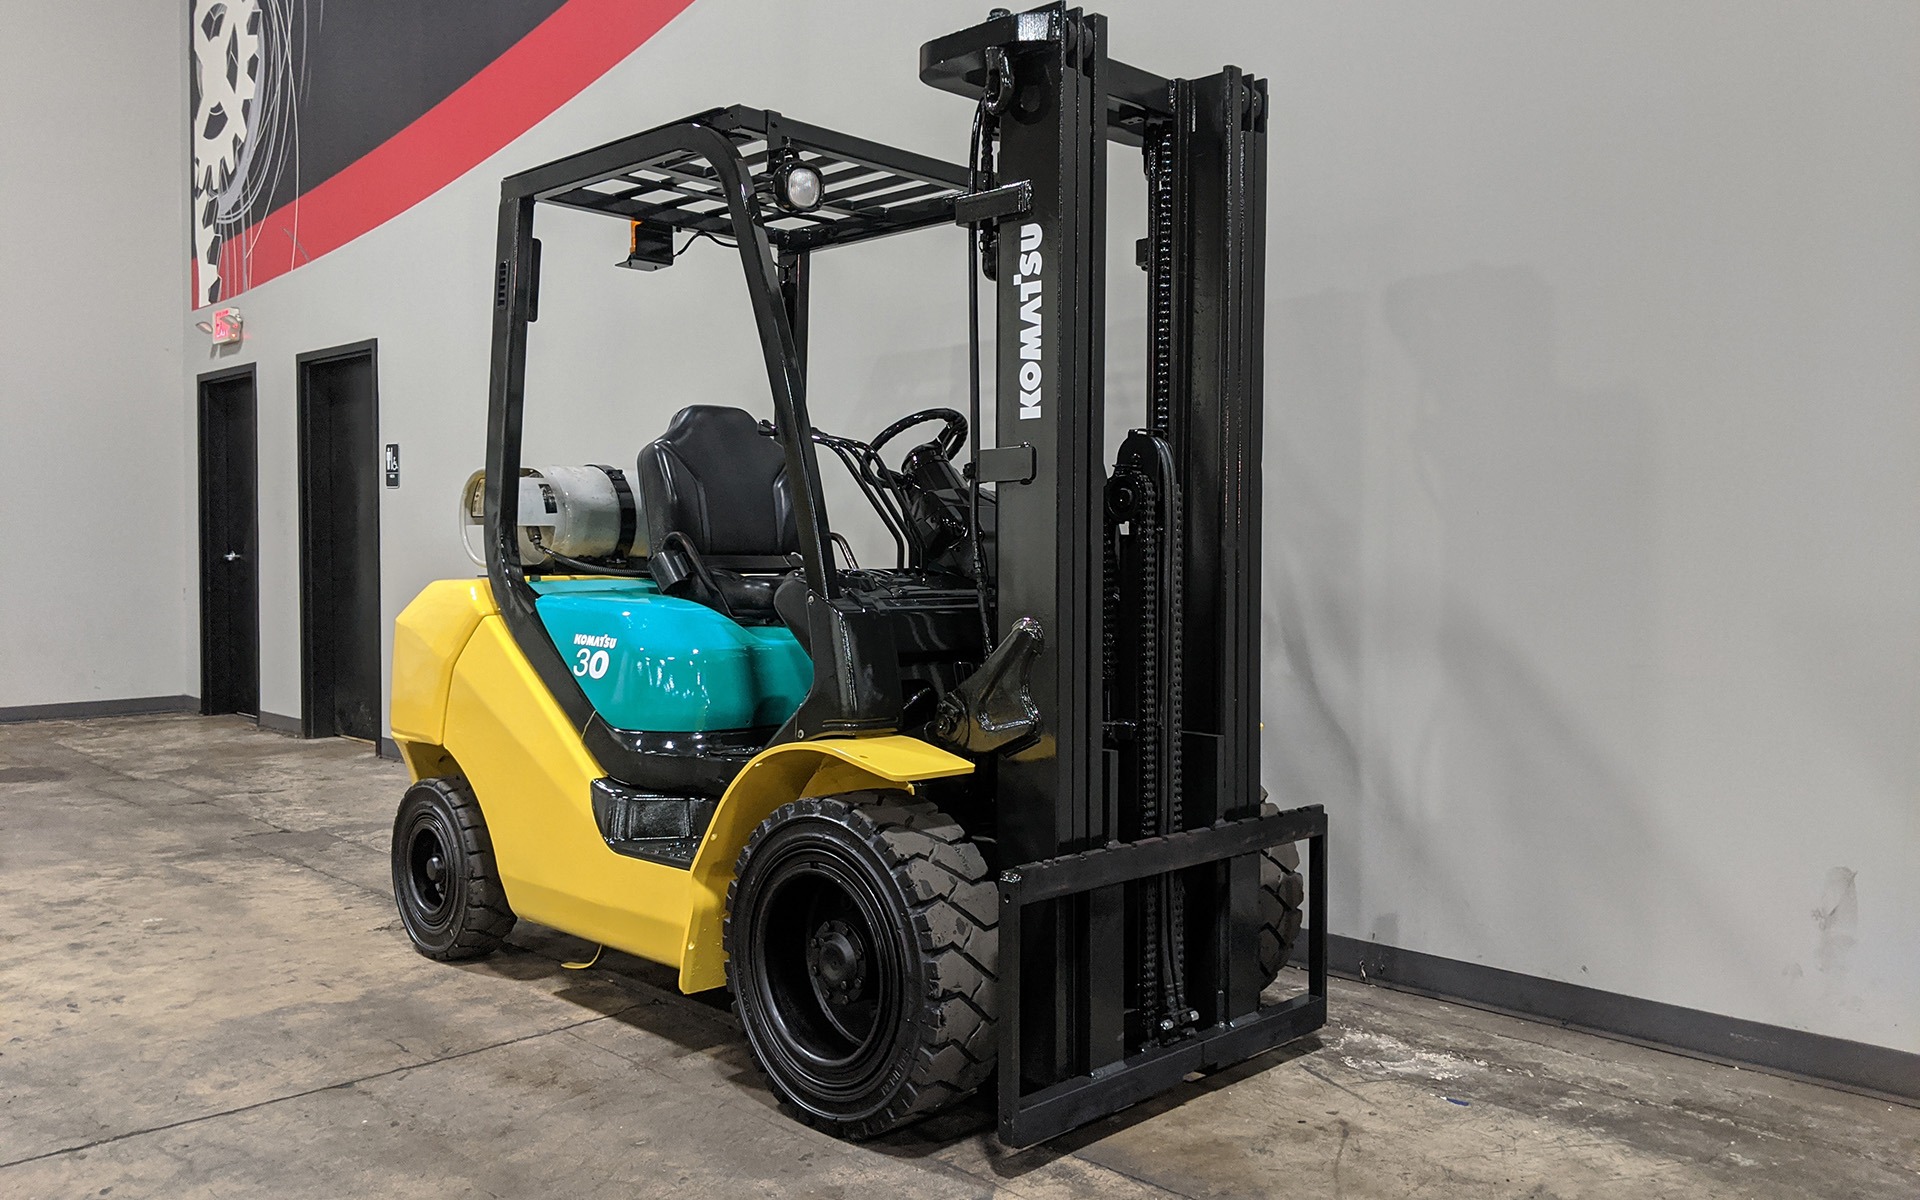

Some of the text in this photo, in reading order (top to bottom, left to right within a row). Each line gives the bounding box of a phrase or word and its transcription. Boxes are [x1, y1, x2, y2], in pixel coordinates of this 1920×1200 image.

[1013, 222, 1043, 420] KOMATSU
[573, 633, 618, 649] KOMATSU
[573, 648, 610, 680] 30
